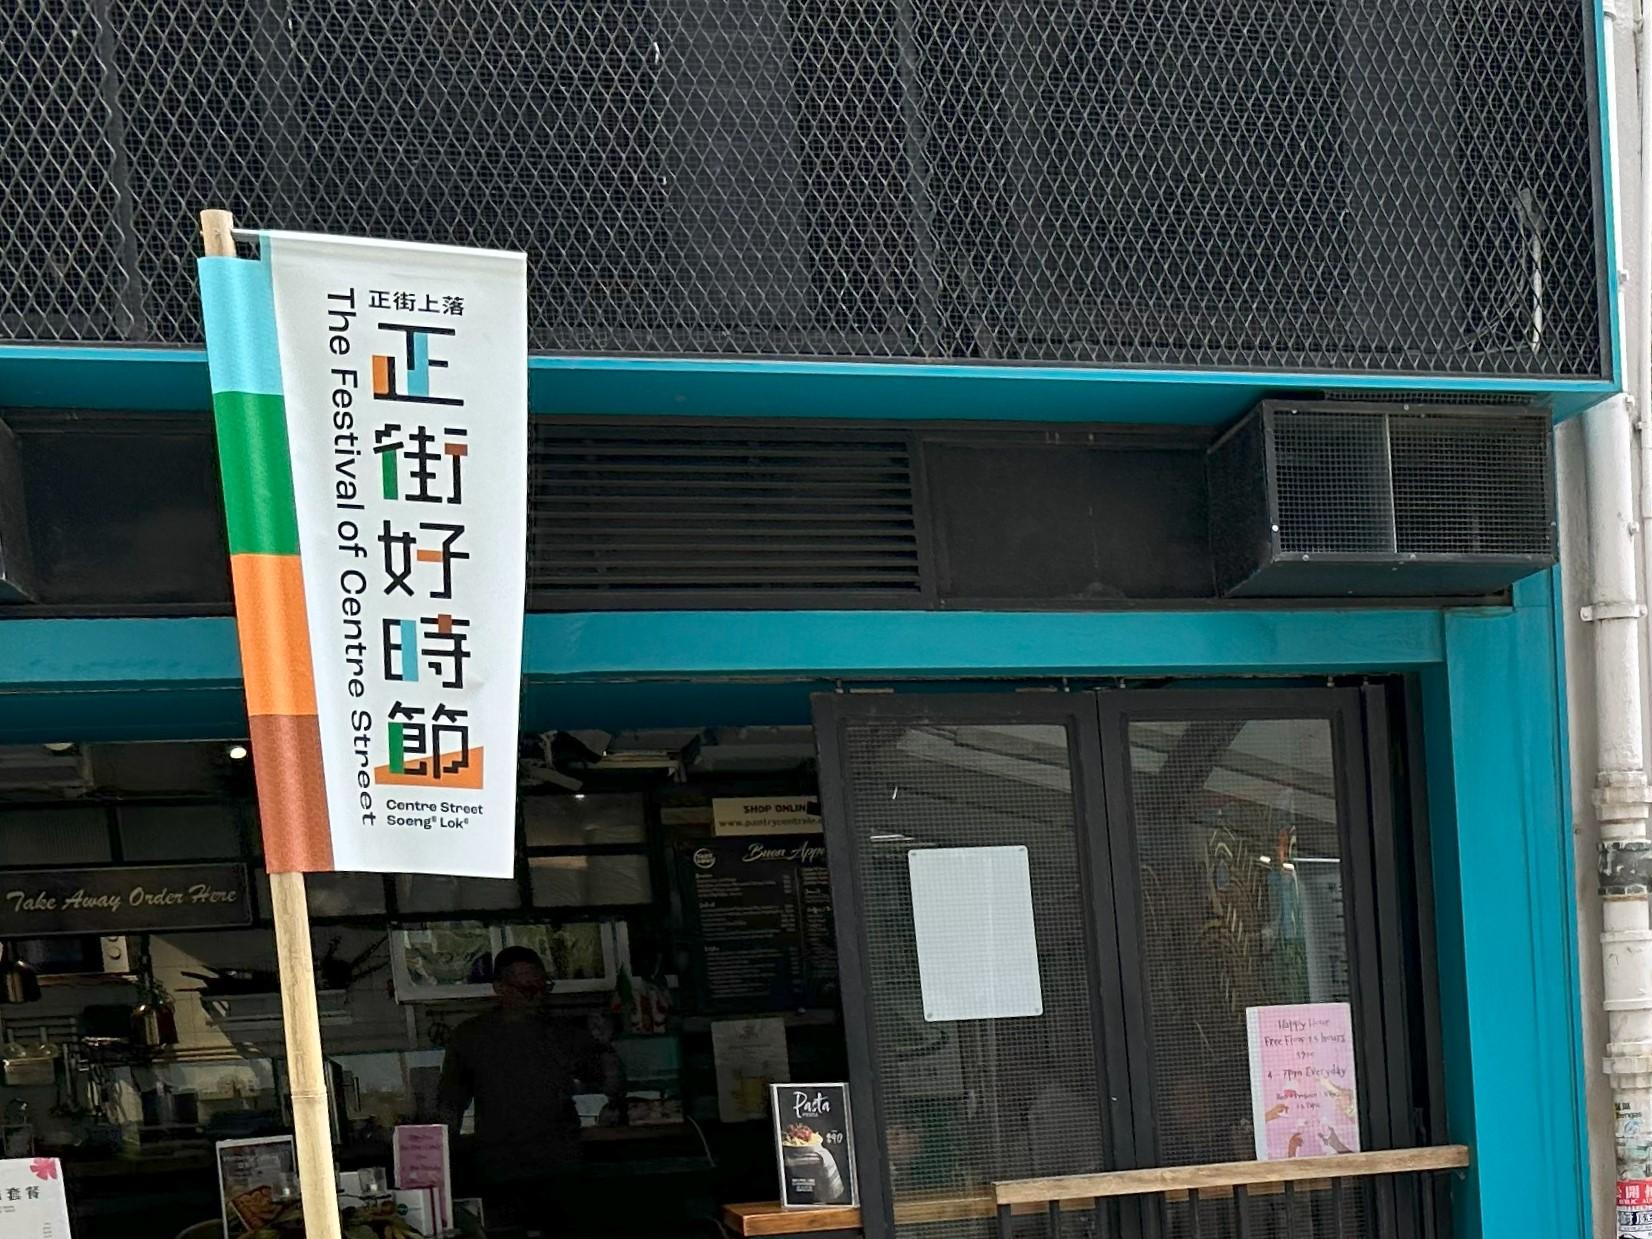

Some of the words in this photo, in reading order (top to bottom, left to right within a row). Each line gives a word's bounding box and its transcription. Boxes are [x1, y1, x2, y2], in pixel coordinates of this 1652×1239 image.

[368, 289, 464, 317] 正街上落
[327, 287, 357, 355] The
[330, 368, 365, 510] Festival
[337, 519, 368, 559] of
[372, 322, 471, 780] 正街好時節
[340, 569, 367, 698] Centre
[350, 709, 377, 826] Street
[386, 799, 437, 812] Centre
[440, 802, 483, 815] Street
[743, 804, 772, 814] SHOP
[775, 803, 806, 813] ONLIN
[6, 891, 56, 912] Take
[61, 888, 121, 912] Away
[128, 886, 184, 906] Order
[187, 884, 237, 904] Here
[1264, 1036, 1283, 1047] Free
[793, 1091, 831, 1118] Pasta
[0, 1186, 40, 1201] 套餐
